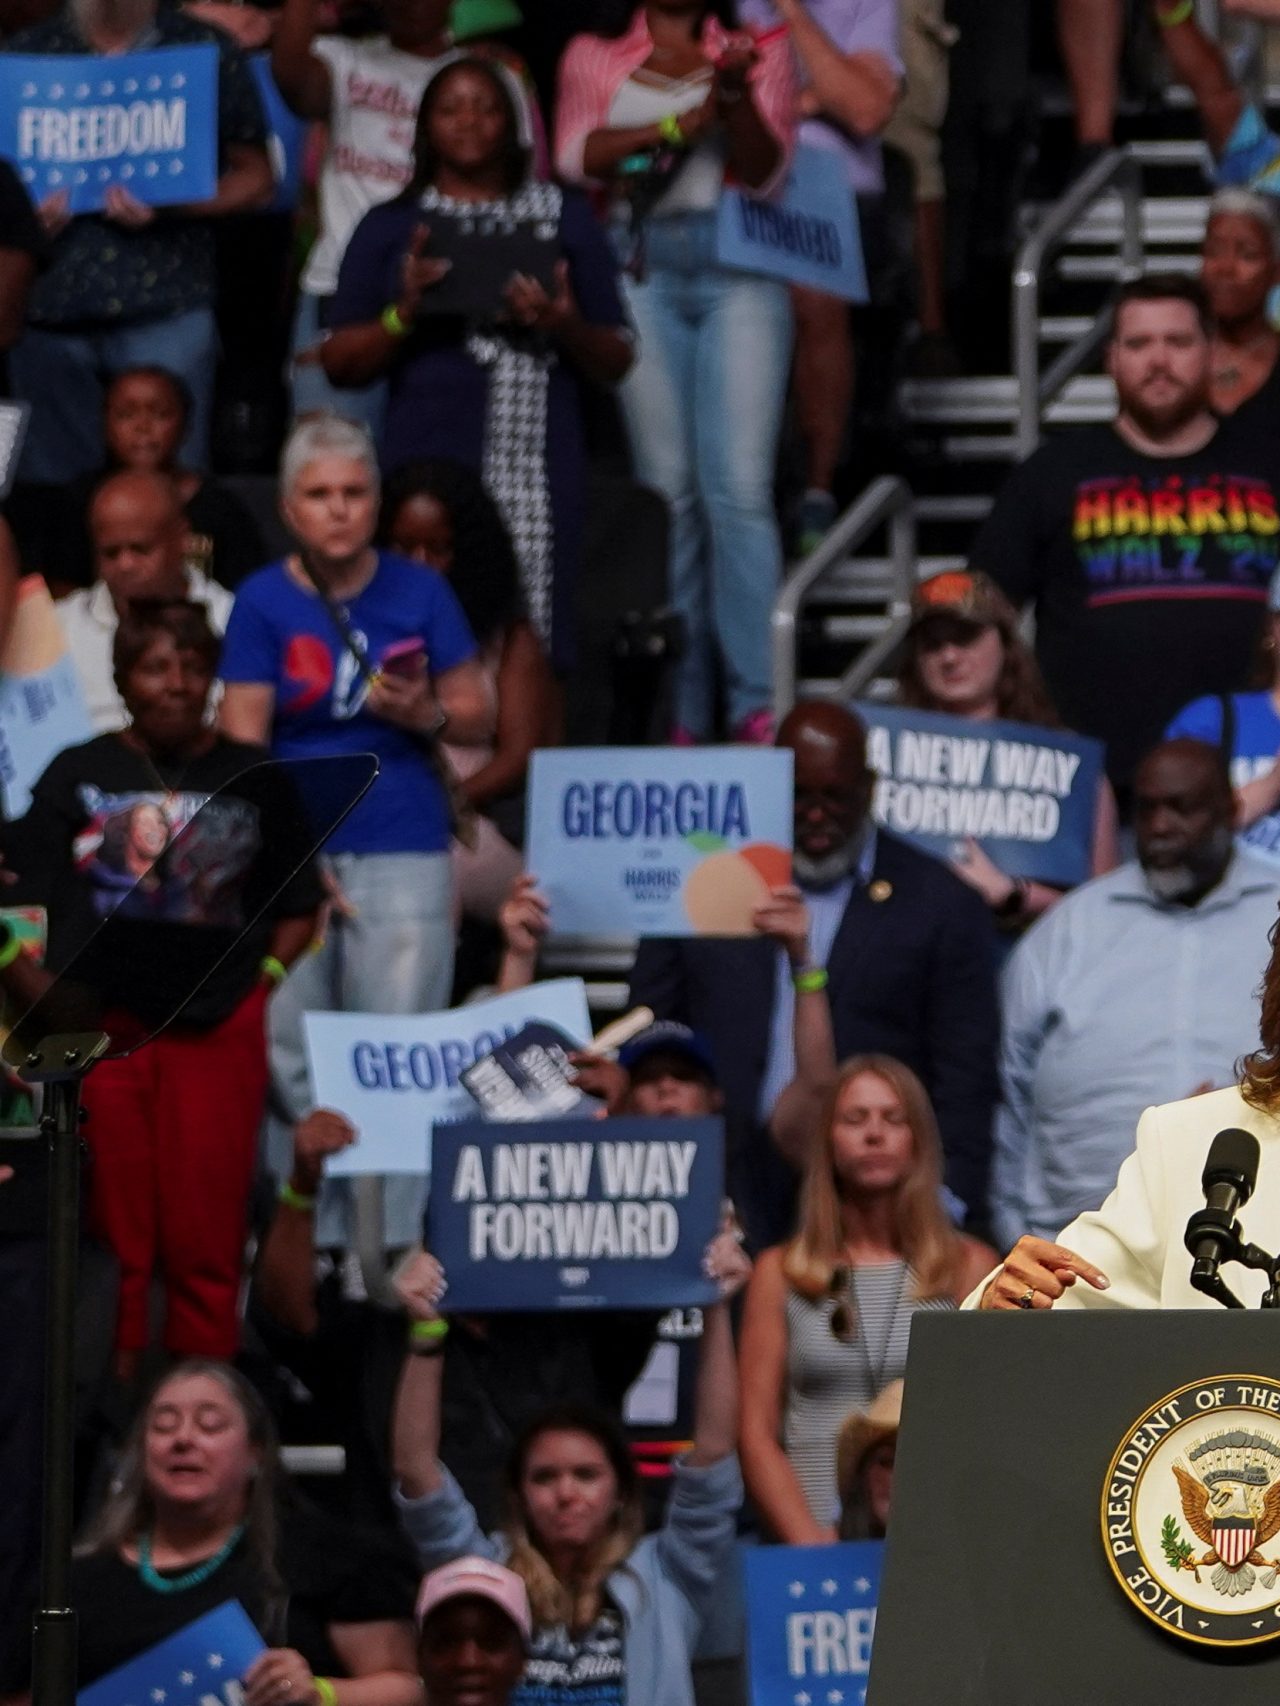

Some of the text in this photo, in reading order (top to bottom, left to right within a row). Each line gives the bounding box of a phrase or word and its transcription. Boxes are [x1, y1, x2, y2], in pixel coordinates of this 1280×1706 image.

[18, 98, 187, 163] FREEDOM
[1073, 487, 1280, 541] HARRIS
[866, 726, 1081, 799] A NEW WAY
[564, 780, 750, 838] GEORGIA
[872, 778, 1060, 842] FORWARD
[453, 1140, 697, 1202] A NEW WAY
[470, 1201, 679, 1262] FORWARD
[1195, 1387, 1226, 1410] OF
[1108, 1399, 1183, 1556] PRESIDENT
[1127, 1566, 1185, 1630] VICE
[785, 1606, 877, 1678] FRE
